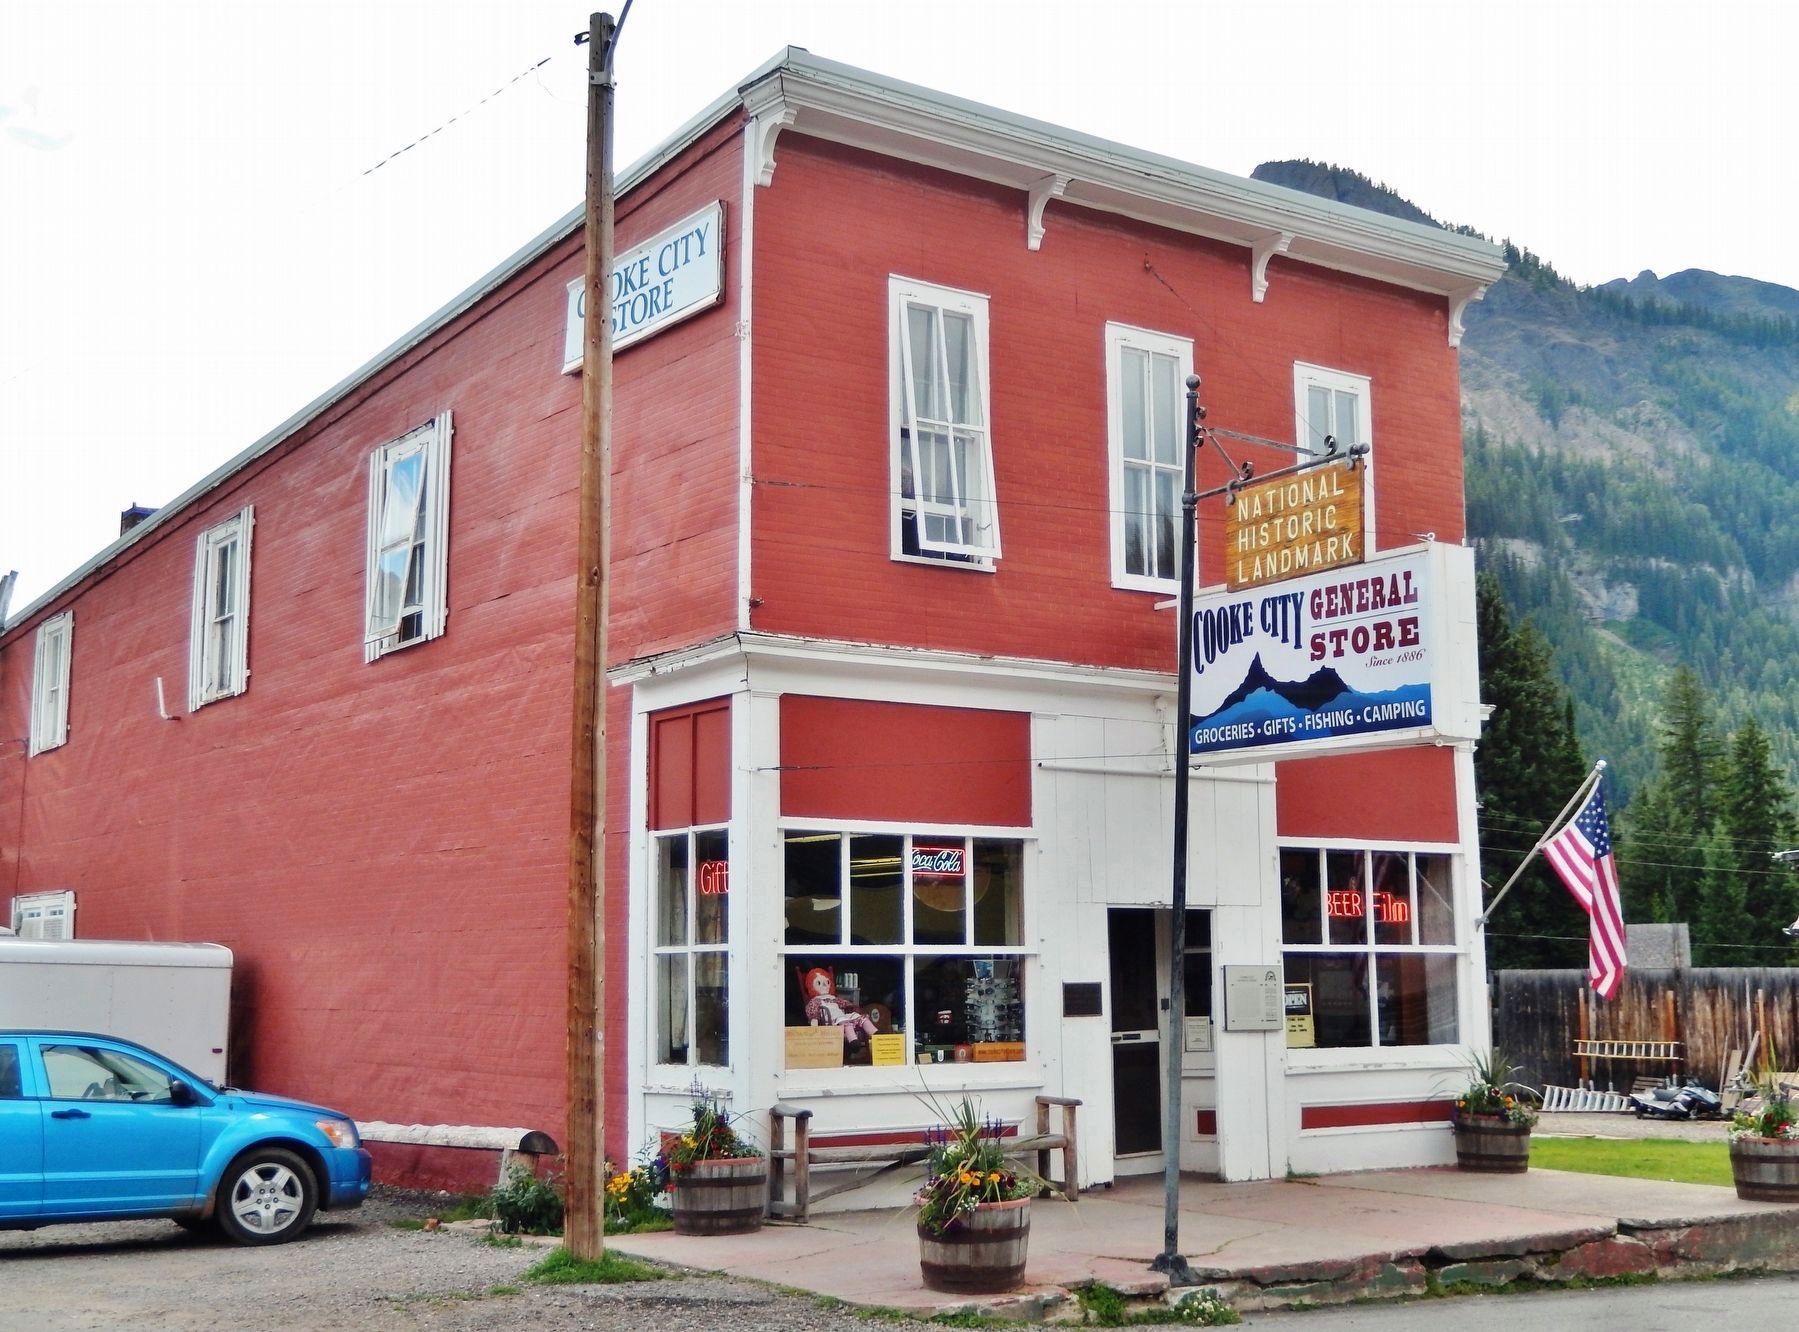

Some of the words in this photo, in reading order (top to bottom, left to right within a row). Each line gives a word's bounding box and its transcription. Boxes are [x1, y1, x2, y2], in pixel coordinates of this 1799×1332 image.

[577, 256, 650, 318] COKE
[658, 222, 711, 278] CITY
[1238, 471, 1344, 522] NATIONAL
[1238, 505, 1336, 553] HISTORIC
[1238, 532, 1353, 583] LANDMARK
[1310, 570, 1418, 620] GENERAL
[1193, 601, 1253, 674] COOKE
[1260, 591, 1305, 650] CITY
[1310, 616, 1420, 661] STORE
[1365, 655, 1393, 668] Since
[1396, 648, 1426, 663] 1886
[1195, 722, 1255, 744] GROCERIES
[1263, 717, 1296, 735] GIFTS
[1304, 709, 1354, 731] FISHING
[1363, 699, 1426, 723] CAMPING
